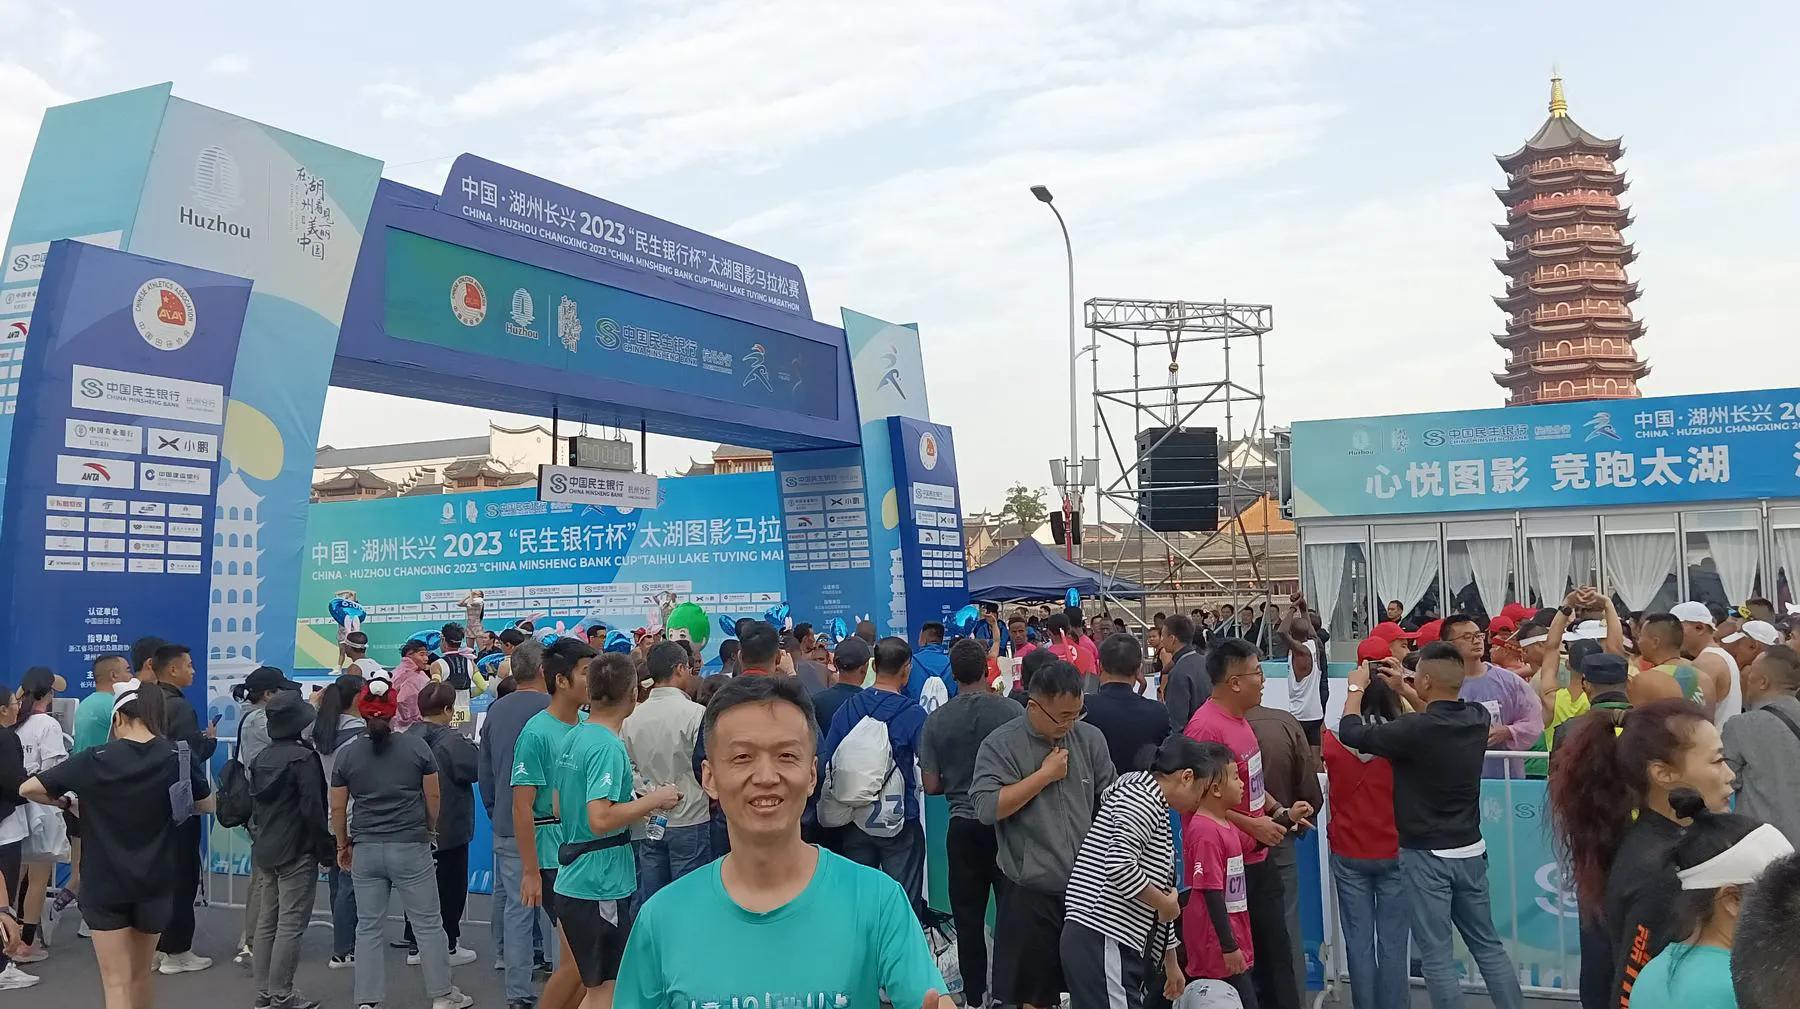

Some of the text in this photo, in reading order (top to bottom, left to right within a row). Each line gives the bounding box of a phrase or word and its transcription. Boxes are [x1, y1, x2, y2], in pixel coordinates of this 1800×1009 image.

[180, 206, 252, 239] Huzhou
[462, 205, 493, 223] CHINA
[499, 216, 537, 236] HUZHOU
[538, 228, 588, 250] CHANGXING
[589, 242, 607, 256] 2023
[635, 256, 674, 275] MINSHENG
[674, 269, 694, 282] BANK
[729, 284, 746, 296] LAKE
[746, 289, 768, 303] TUYING
[768, 296, 800, 312] MARATHON
[579, 211, 626, 246] 2023
[708, 253, 800, 299] 太湖图影马拉松赛
[505, 321, 539, 340] Huzhou
[622, 325, 698, 358] 中国民生银行
[106, 382, 180, 402] 中国民生银行
[106, 394, 128, 402] CHINA
[128, 397, 161, 407] MINSHENG
[1449, 424, 1528, 439] 中国民生银行
[1635, 429, 1669, 439] CHINA
[1676, 426, 1723, 437] HUZHOU
[1725, 422, 1790, 433] CHANGXING
[81, 472, 100, 482] ANTA
[1365, 444, 1731, 499] 心悦图影 竞跑太湖
[569, 476, 625, 492] 中国民生银行
[443, 531, 503, 558] 2023
[312, 570, 343, 581] CHINA
[350, 567, 391, 579] HUZHOU
[393, 564, 451, 577] CHANGXING
[453, 563, 477, 574] 2023
[519, 557, 577, 570] MINSHENG
[580, 556, 612, 568] BANK
[678, 552, 709, 564] LAKE
[712, 550, 758, 562] TUYING
[88, 607, 119, 616] 认证单位
[68, 644, 132, 652] 浙江省马拉松及路跑协
[87, 634, 118, 643] 指导单位
